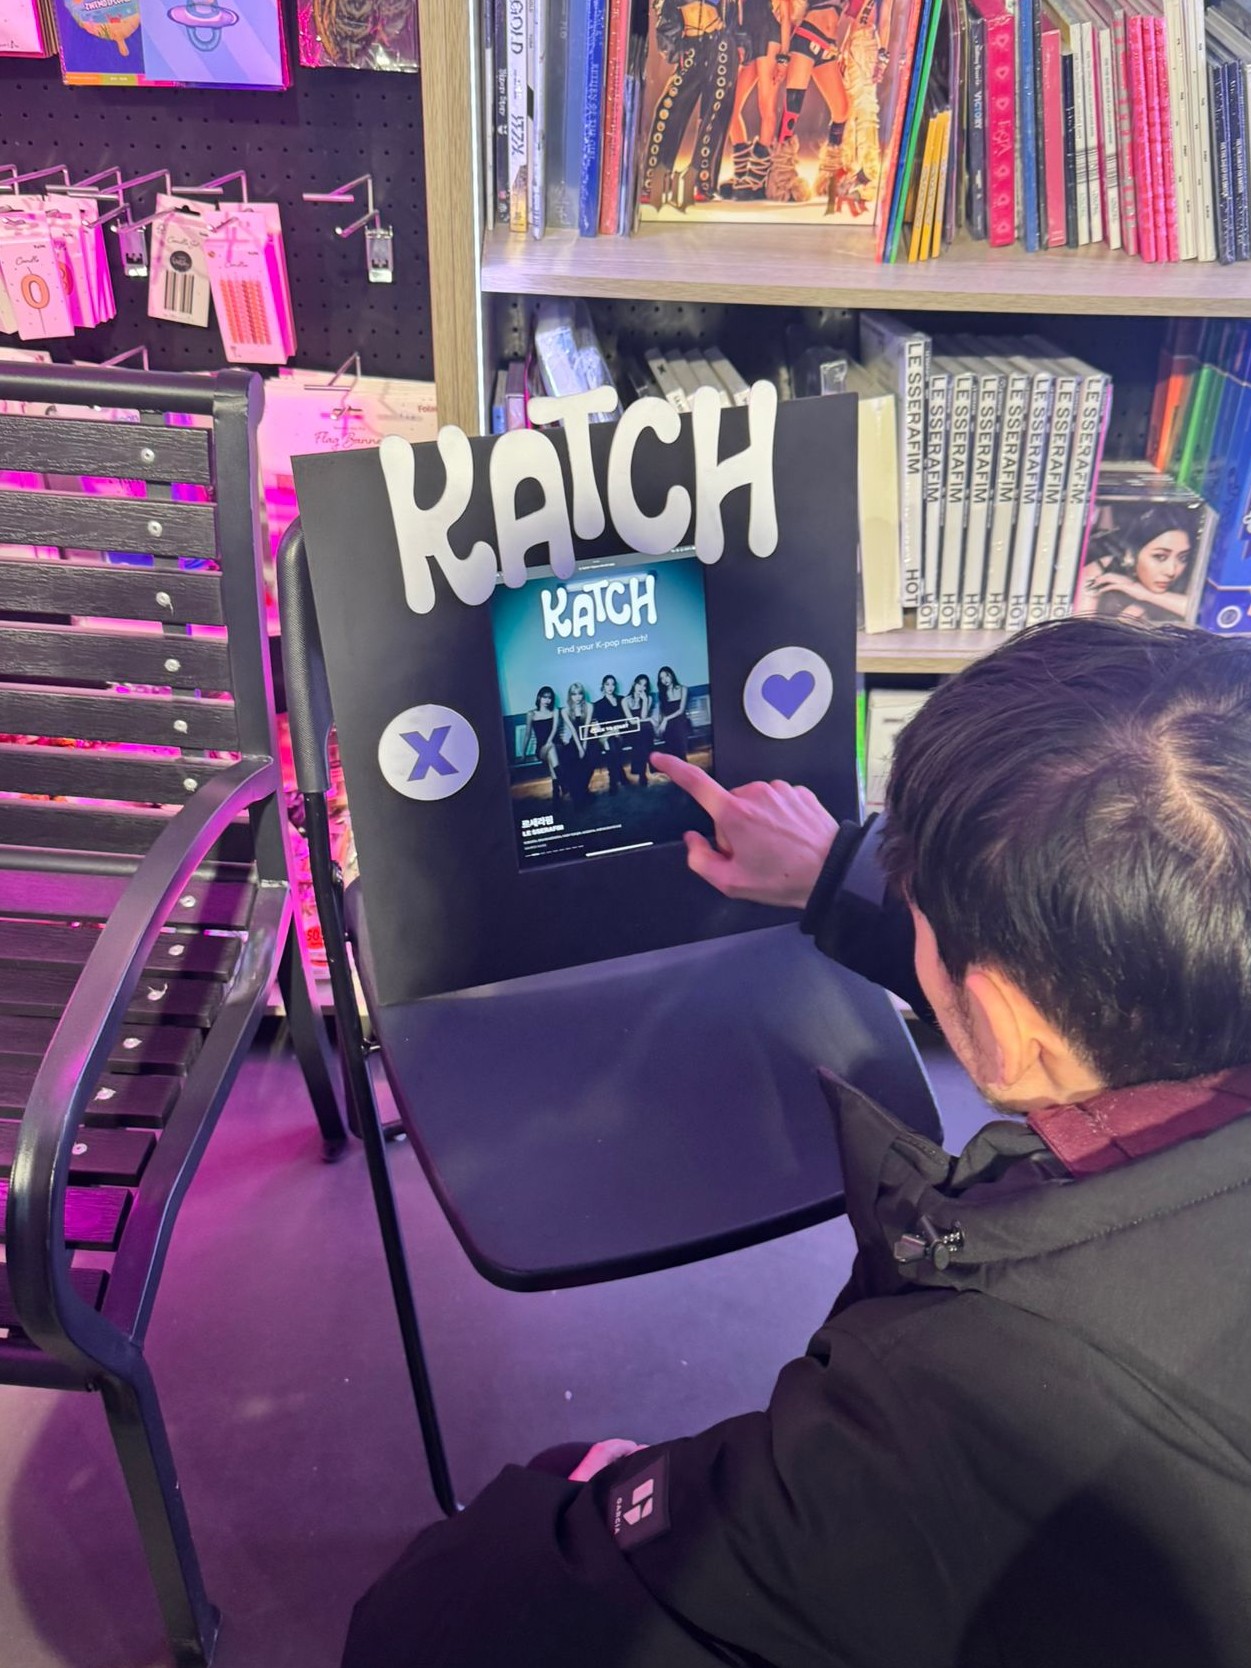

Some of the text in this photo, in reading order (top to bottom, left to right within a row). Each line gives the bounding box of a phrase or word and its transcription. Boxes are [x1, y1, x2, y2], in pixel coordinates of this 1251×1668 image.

[974, 91, 982, 129] VICTORY
[905, 342, 922, 475] LE SSERAFIM
[342, 432, 382, 449] Banne
[926, 377, 947, 503] LE SSERAFIM
[949, 377, 971, 503] LE SSERAFIM
[973, 377, 997, 503] LE SSERAFIM
[1000, 376, 1026, 502] LE SSERAFIM
[1023, 378, 1050, 504] LE SSERAFIM
[1046, 378, 1075, 504] LE SSERAFIM
[1070, 377, 1100, 504] LE SSERAFIM
[379, 379, 779, 614] KATCH
[541, 574, 658, 640] KATCH
[904, 569, 919, 605] HOT
[941, 593, 956, 628] HOT
[964, 593, 979, 628] HOT
[987, 592, 1003, 627] HOT
[1009, 594, 1025, 629] HOT
[1031, 594, 1046, 618] HO
[1053, 594, 1068, 618] HO
[557, 634, 648, 655] Find your K-pop match!
